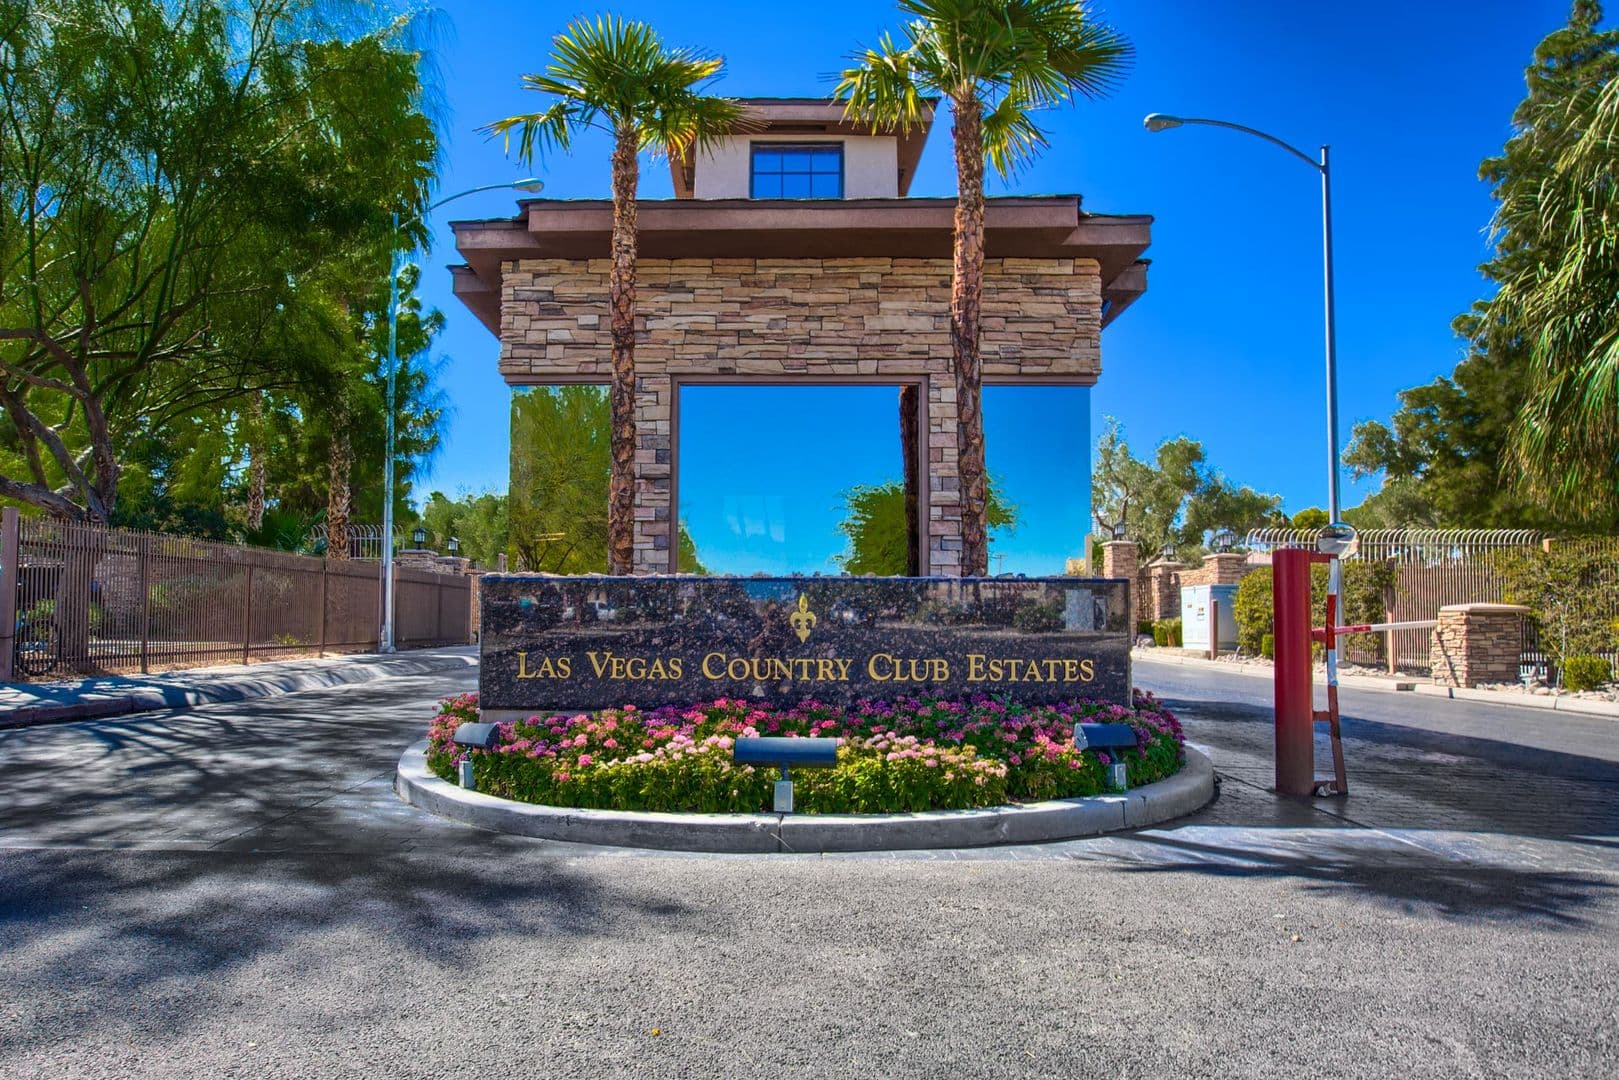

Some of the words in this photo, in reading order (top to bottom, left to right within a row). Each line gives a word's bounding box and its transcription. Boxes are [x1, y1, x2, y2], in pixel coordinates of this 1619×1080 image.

[516, 651, 571, 679] LAS
[586, 651, 683, 679] VEGAS
[701, 652, 853, 681] COUNTRY
[868, 653, 950, 682] CLUB
[966, 653, 1095, 683] ESTATES
